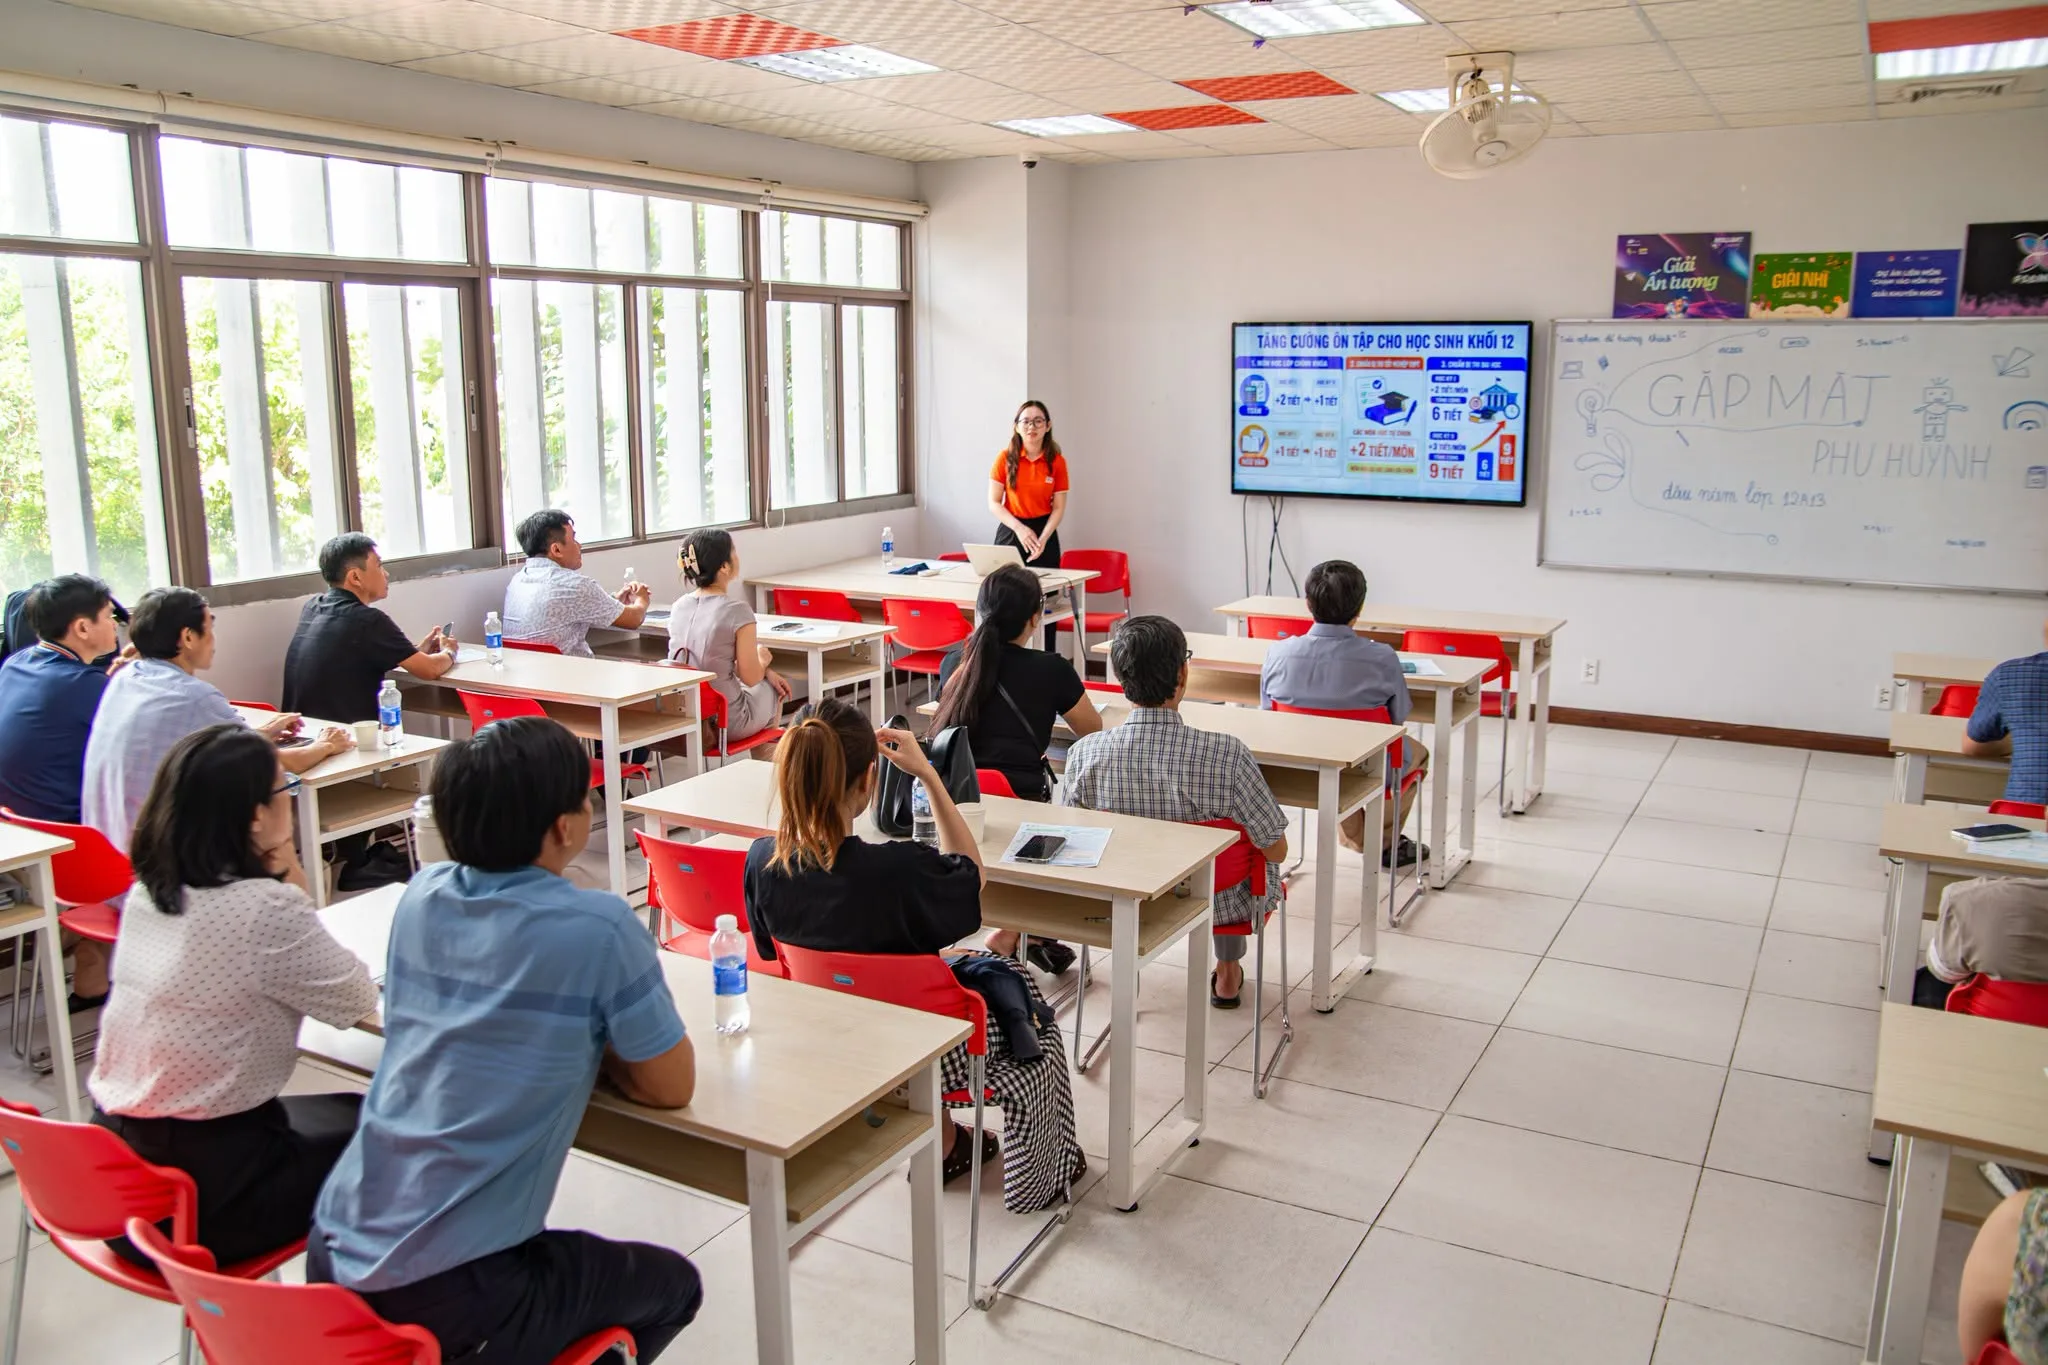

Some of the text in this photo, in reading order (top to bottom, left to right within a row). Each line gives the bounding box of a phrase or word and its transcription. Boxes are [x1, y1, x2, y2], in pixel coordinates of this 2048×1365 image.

[1663, 255, 1697, 274] Giải
[1642, 268, 1667, 292] Ấn
[1771, 268, 1800, 289] GIẢI
[1353, 331, 1374, 352] TẬP
[1377, 334, 1402, 349] CHO
[1406, 334, 1430, 352] HỌC
[1434, 334, 1464, 349] SINH
[1468, 330, 1498, 349] KHỐI
[1501, 334, 1514, 349] 12
[1275, 394, 1286, 406] +2
[1315, 395, 1324, 406] +1
[1432, 406, 1463, 421] 6 TIẾT
[1275, 446, 1285, 457] +1
[1314, 447, 1323, 458] +1
[1350, 442, 1415, 458] +2 TIẾT/MÔN
[1503, 442, 1512, 456] 9
[1430, 463, 1439, 478] 9
[1442, 463, 1464, 479] TIẾT
[1481, 459, 1489, 471] 6
